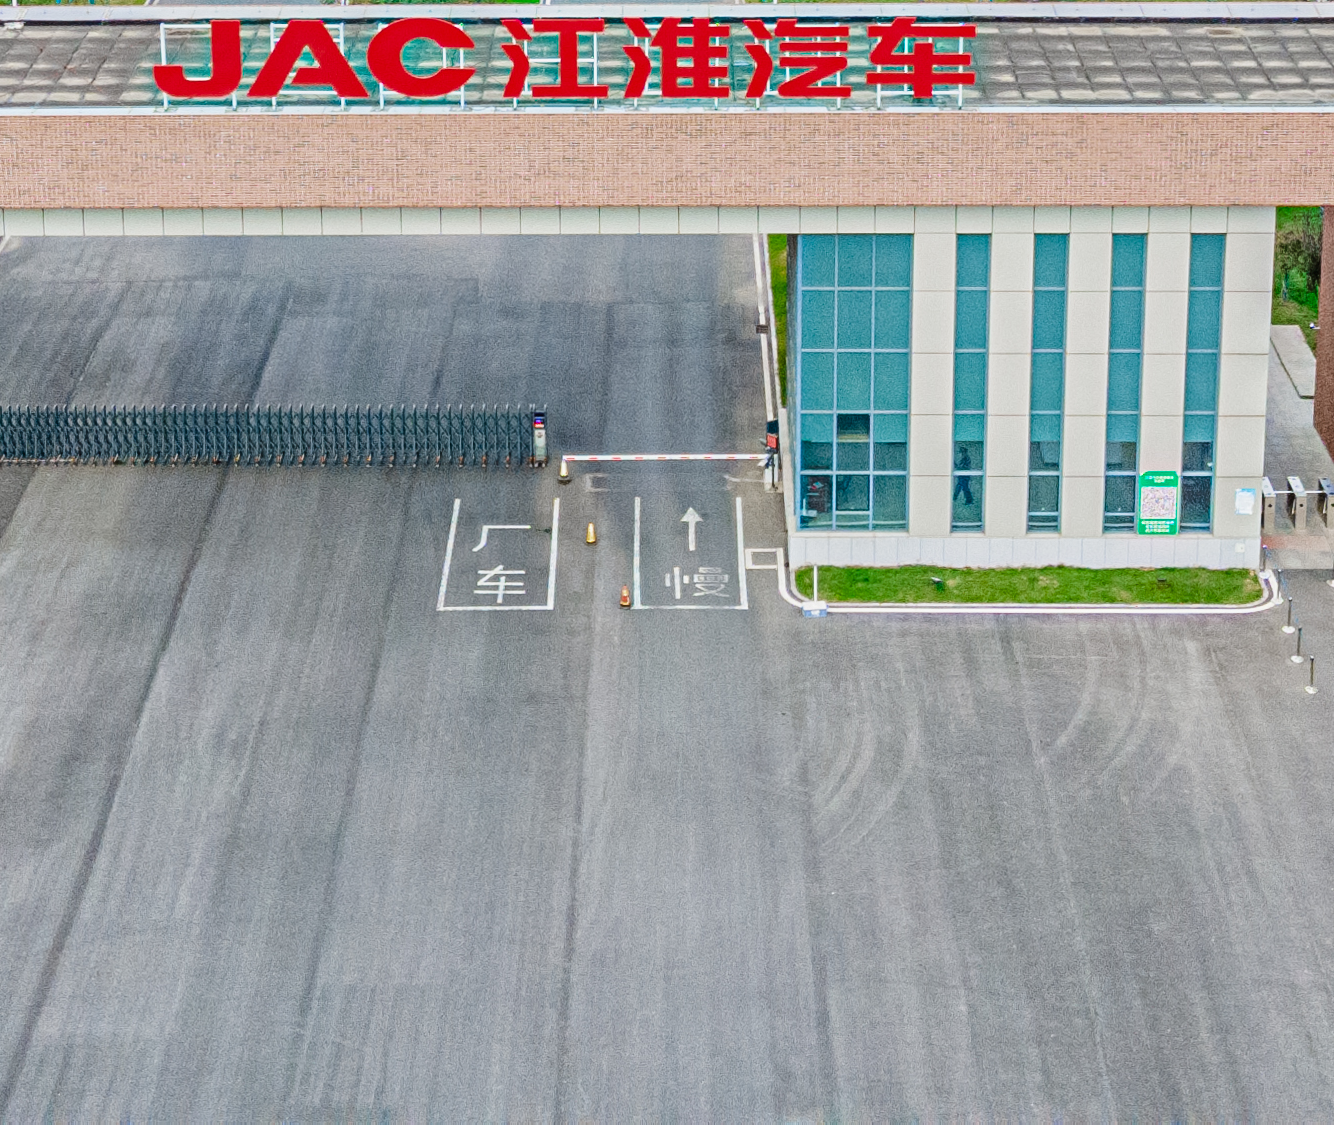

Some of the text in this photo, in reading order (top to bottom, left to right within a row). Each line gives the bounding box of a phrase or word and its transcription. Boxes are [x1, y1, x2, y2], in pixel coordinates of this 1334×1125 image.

[153, 16, 977, 99] JAC 江淮汽车
[665, 566, 729, 600] 慢
